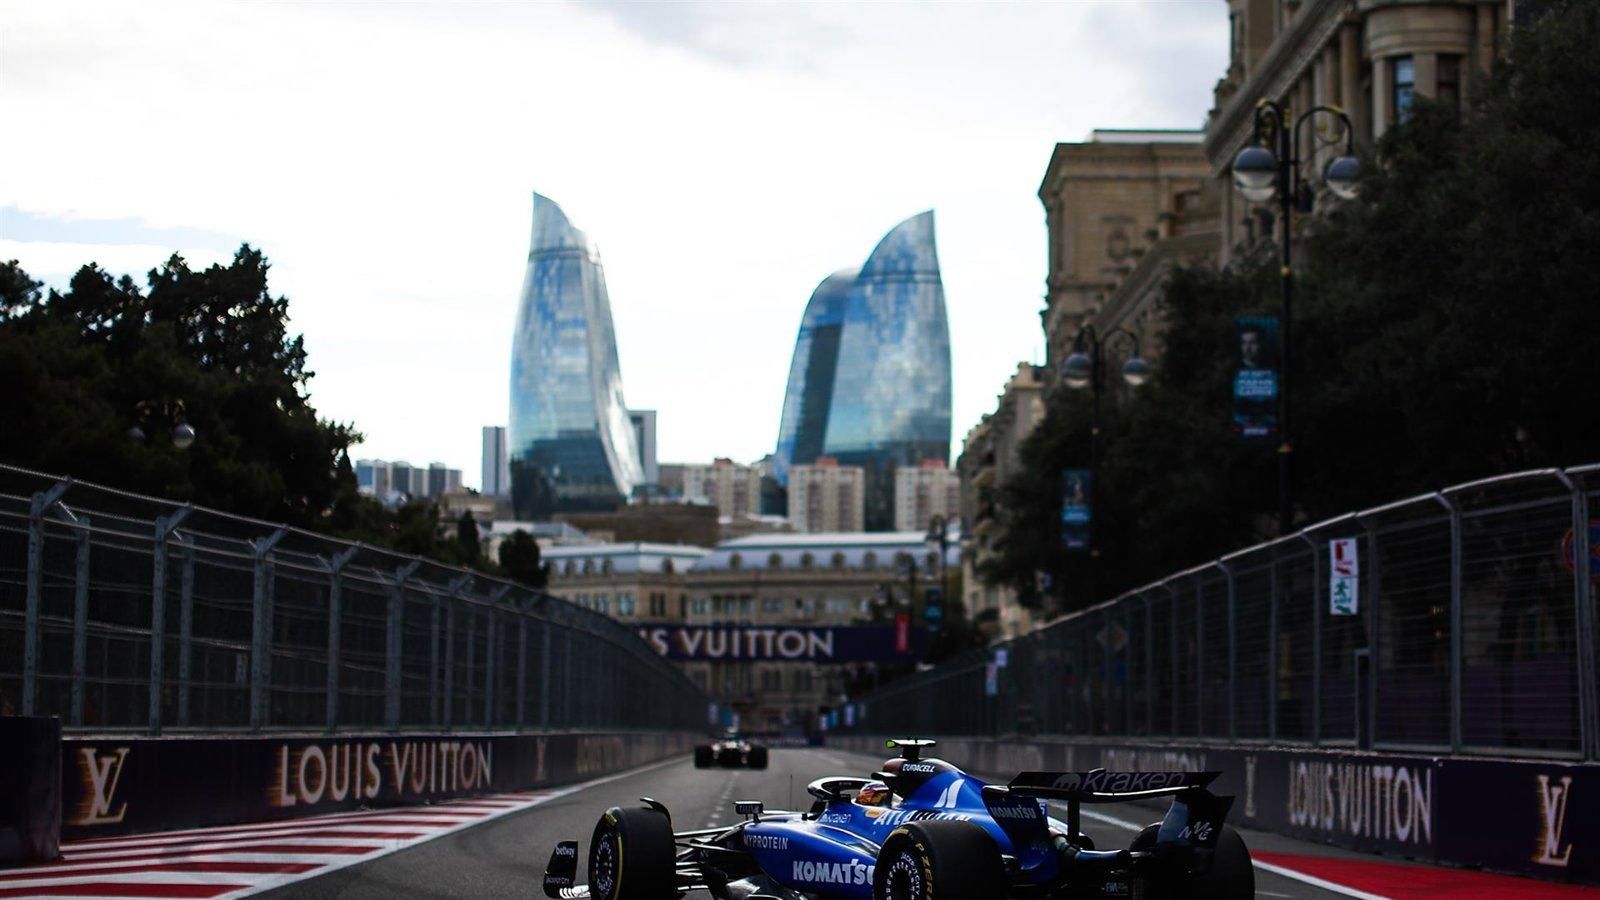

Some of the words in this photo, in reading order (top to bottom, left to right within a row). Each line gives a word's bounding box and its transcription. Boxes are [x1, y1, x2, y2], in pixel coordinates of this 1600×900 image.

[680, 629, 834, 658] VUITTON
[281, 743, 381, 807] LOUIS
[391, 741, 492, 795] VUITTON
[902, 763, 936, 773] DURACELL
[990, 803, 1037, 819] KOMATSU
[1289, 760, 1335, 831] LOUIS
[1337, 763, 1433, 845] VUITTON
